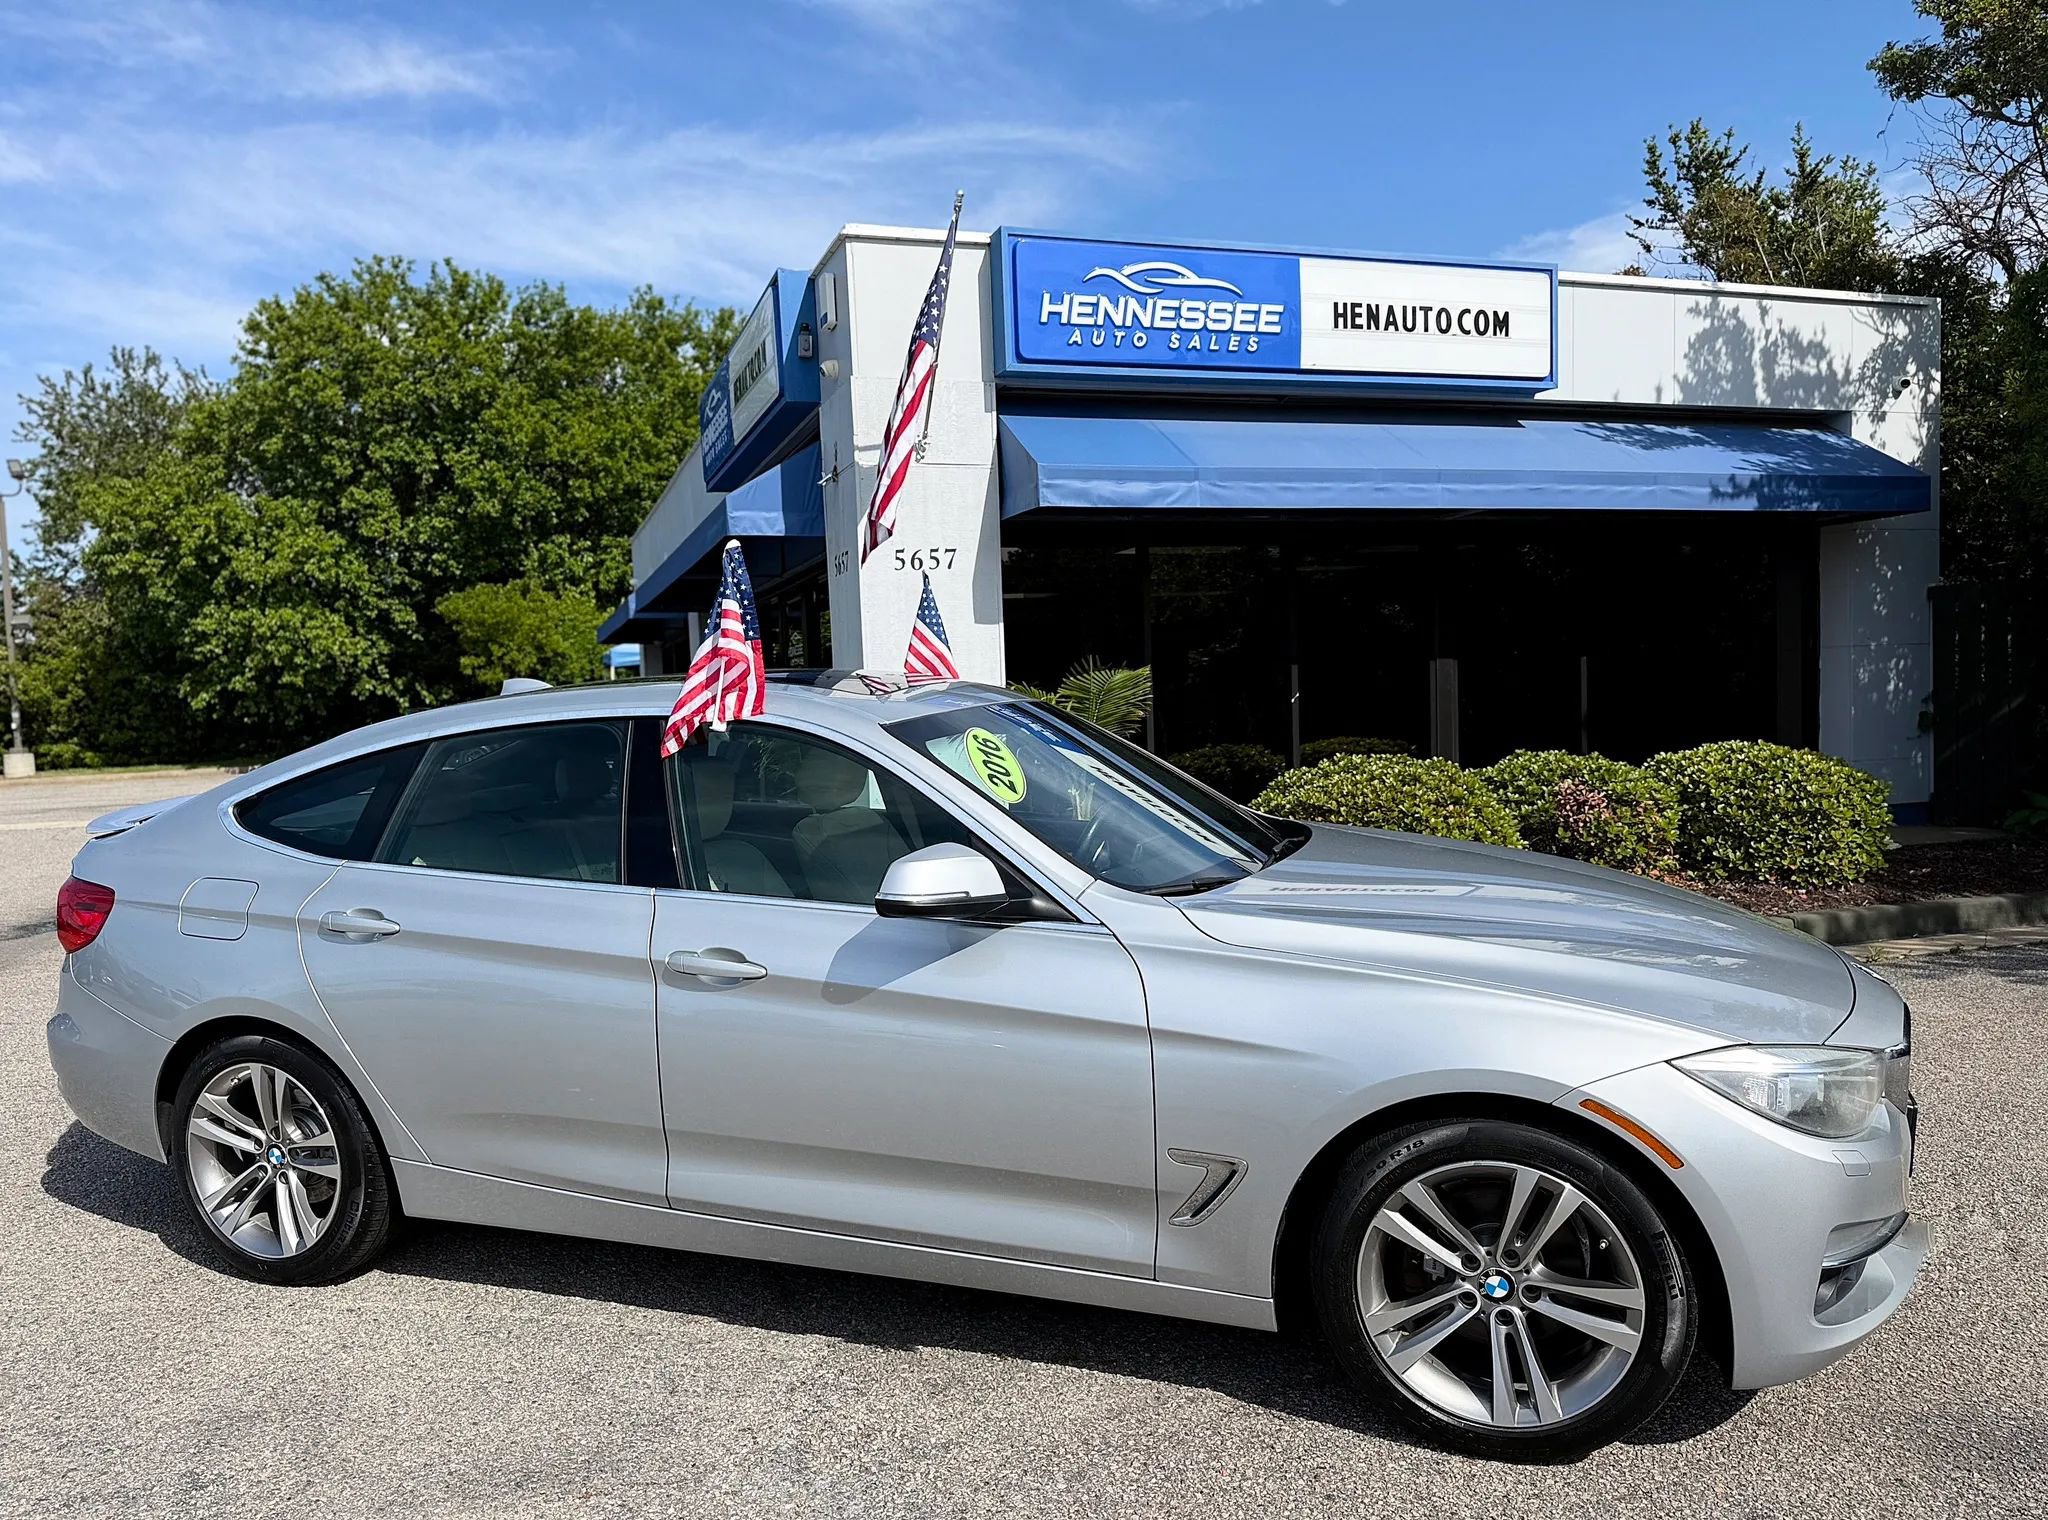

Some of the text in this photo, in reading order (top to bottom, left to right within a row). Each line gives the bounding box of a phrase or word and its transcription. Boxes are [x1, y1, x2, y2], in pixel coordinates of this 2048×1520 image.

[1039, 291, 1284, 334] HENNESSEE
[1068, 327, 1260, 352] AUTO SALES
[894, 547, 957, 571] 5657
[972, 734, 1018, 795] 2016
[1389, 1139, 1425, 1161] R18
